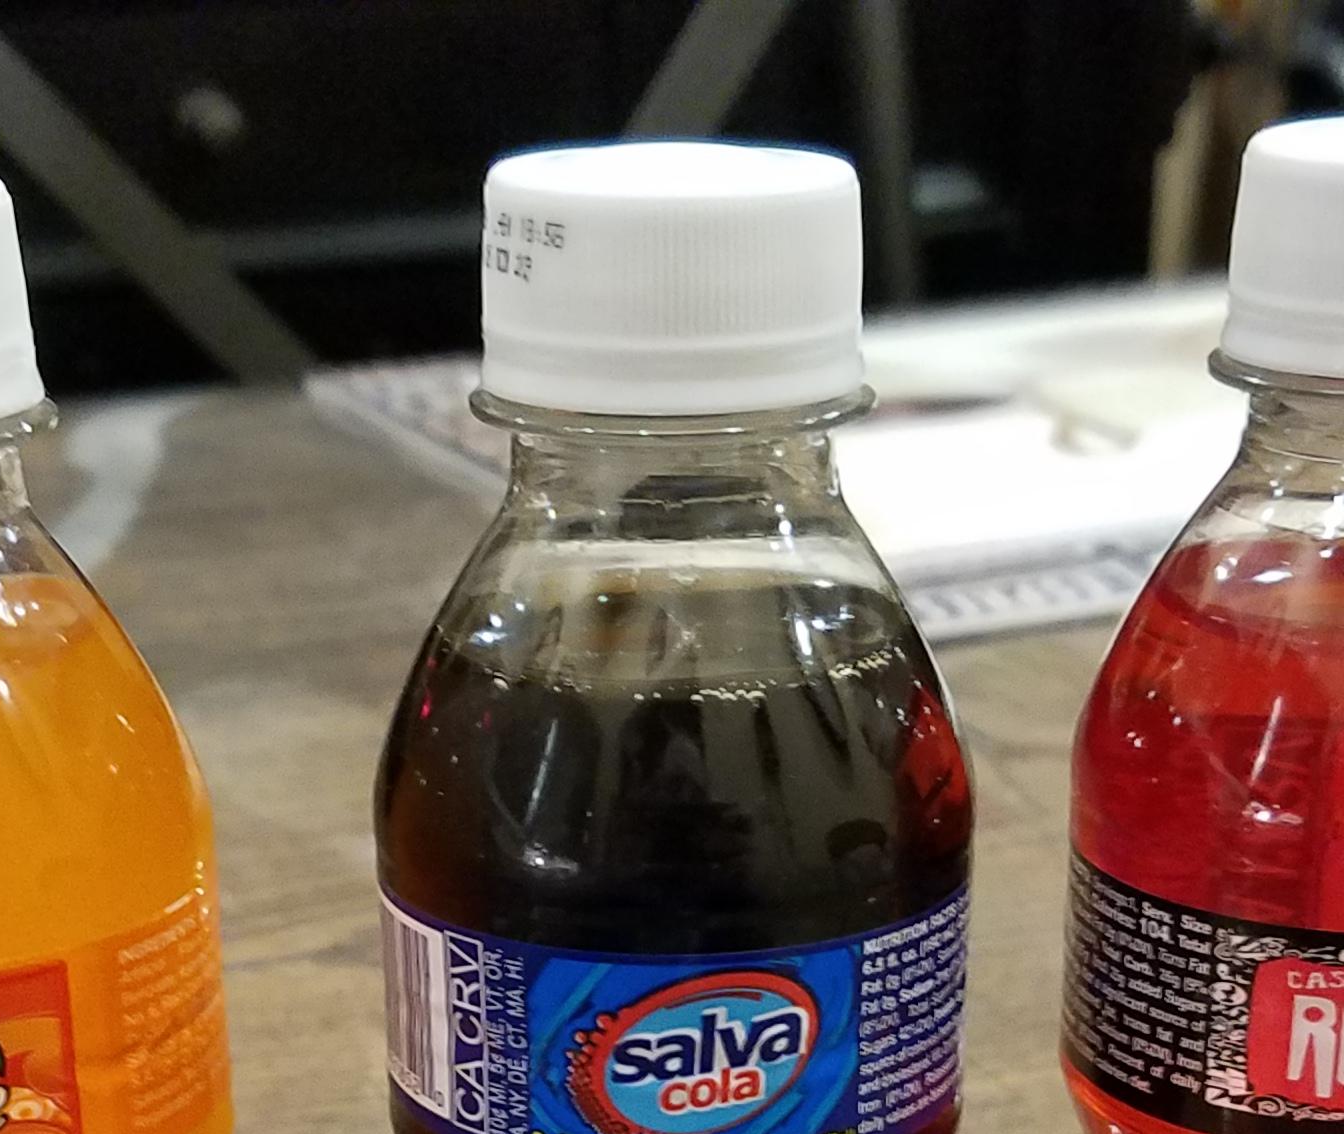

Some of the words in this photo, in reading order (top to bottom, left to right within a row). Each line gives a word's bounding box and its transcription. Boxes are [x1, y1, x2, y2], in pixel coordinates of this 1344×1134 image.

[447, 938, 484, 1046] CRV
[609, 1005, 808, 1086] salva
[454, 1058, 485, 1123] CA
[658, 1066, 765, 1114] cola
